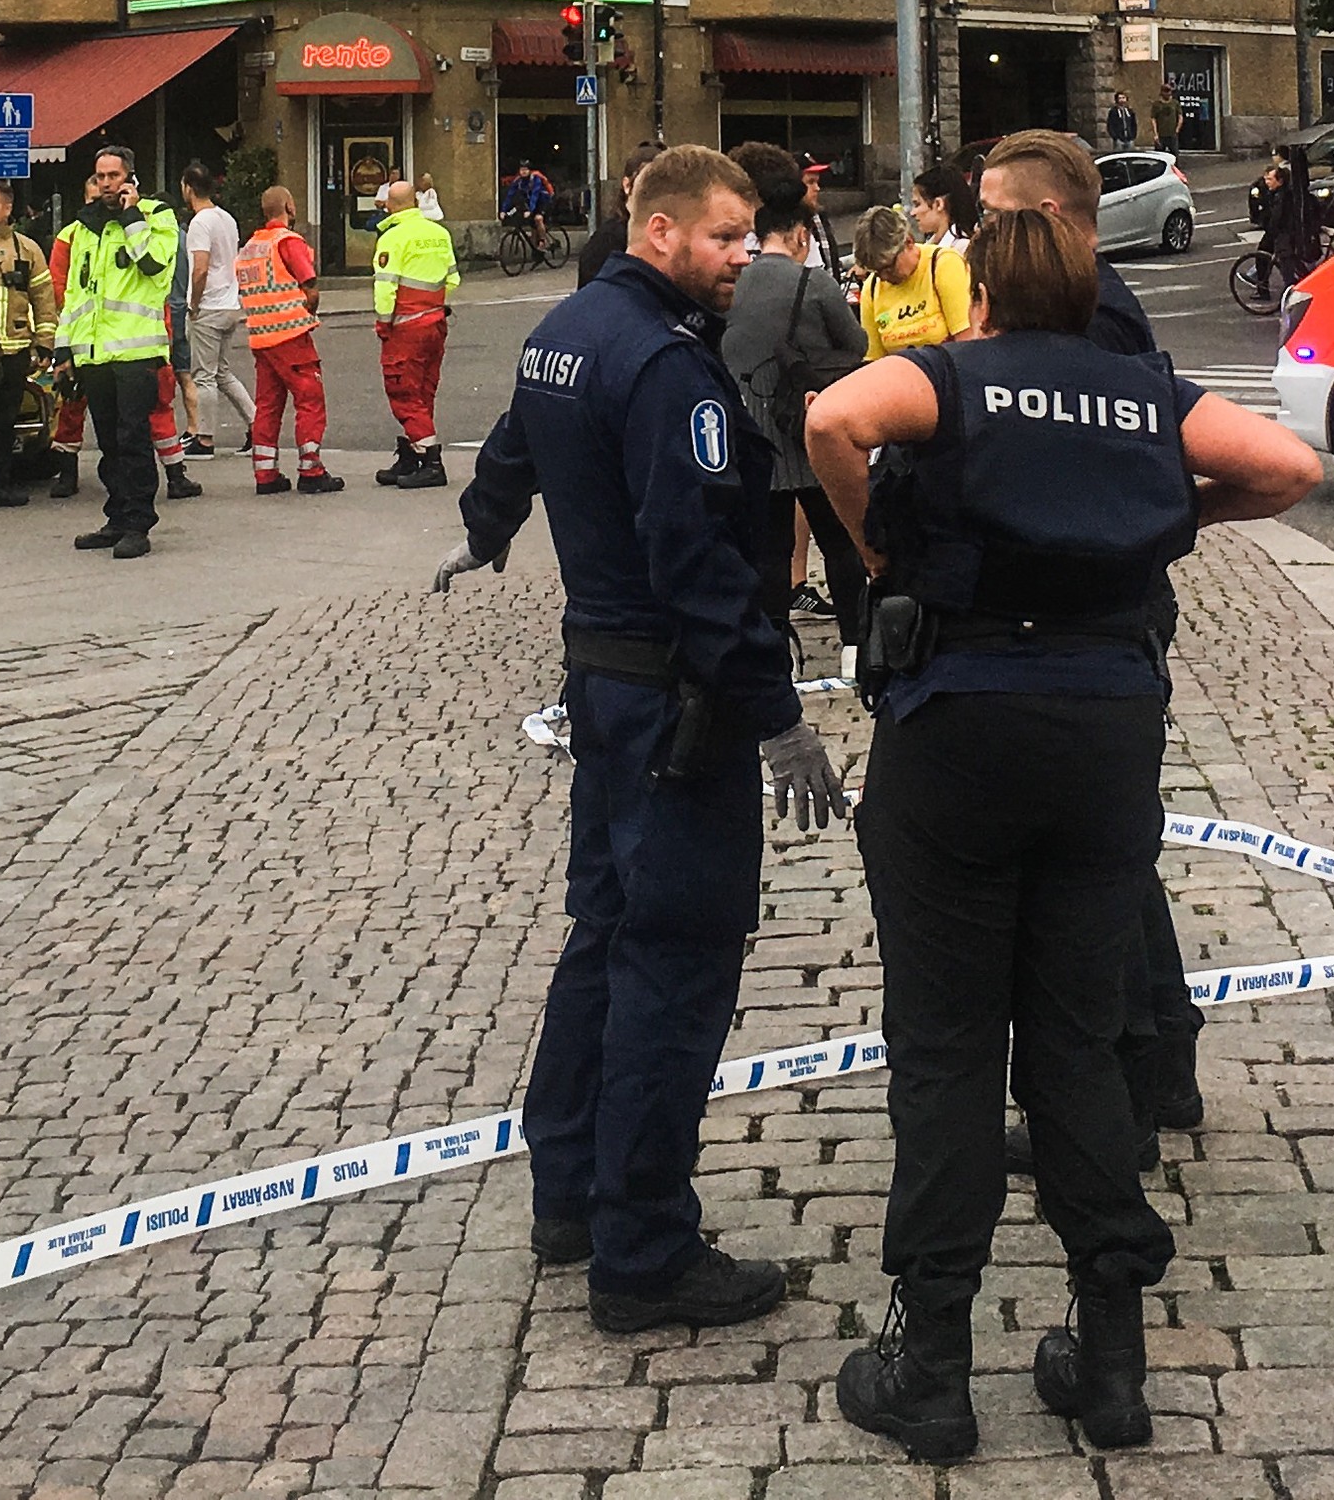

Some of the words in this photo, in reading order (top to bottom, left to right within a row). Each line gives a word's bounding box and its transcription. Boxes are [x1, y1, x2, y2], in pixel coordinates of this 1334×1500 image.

[302, 38, 393, 68] rento
[984, 385, 1159, 434] POLIISI
[1190, 983, 1210, 999] POL
[1236, 971, 1294, 992] AVSPÄRRAT
[333, 1159, 368, 1183] POLIS
[222, 1177, 295, 1212] AVSPÄRRAT
[146, 1205, 189, 1232] POLIISI
